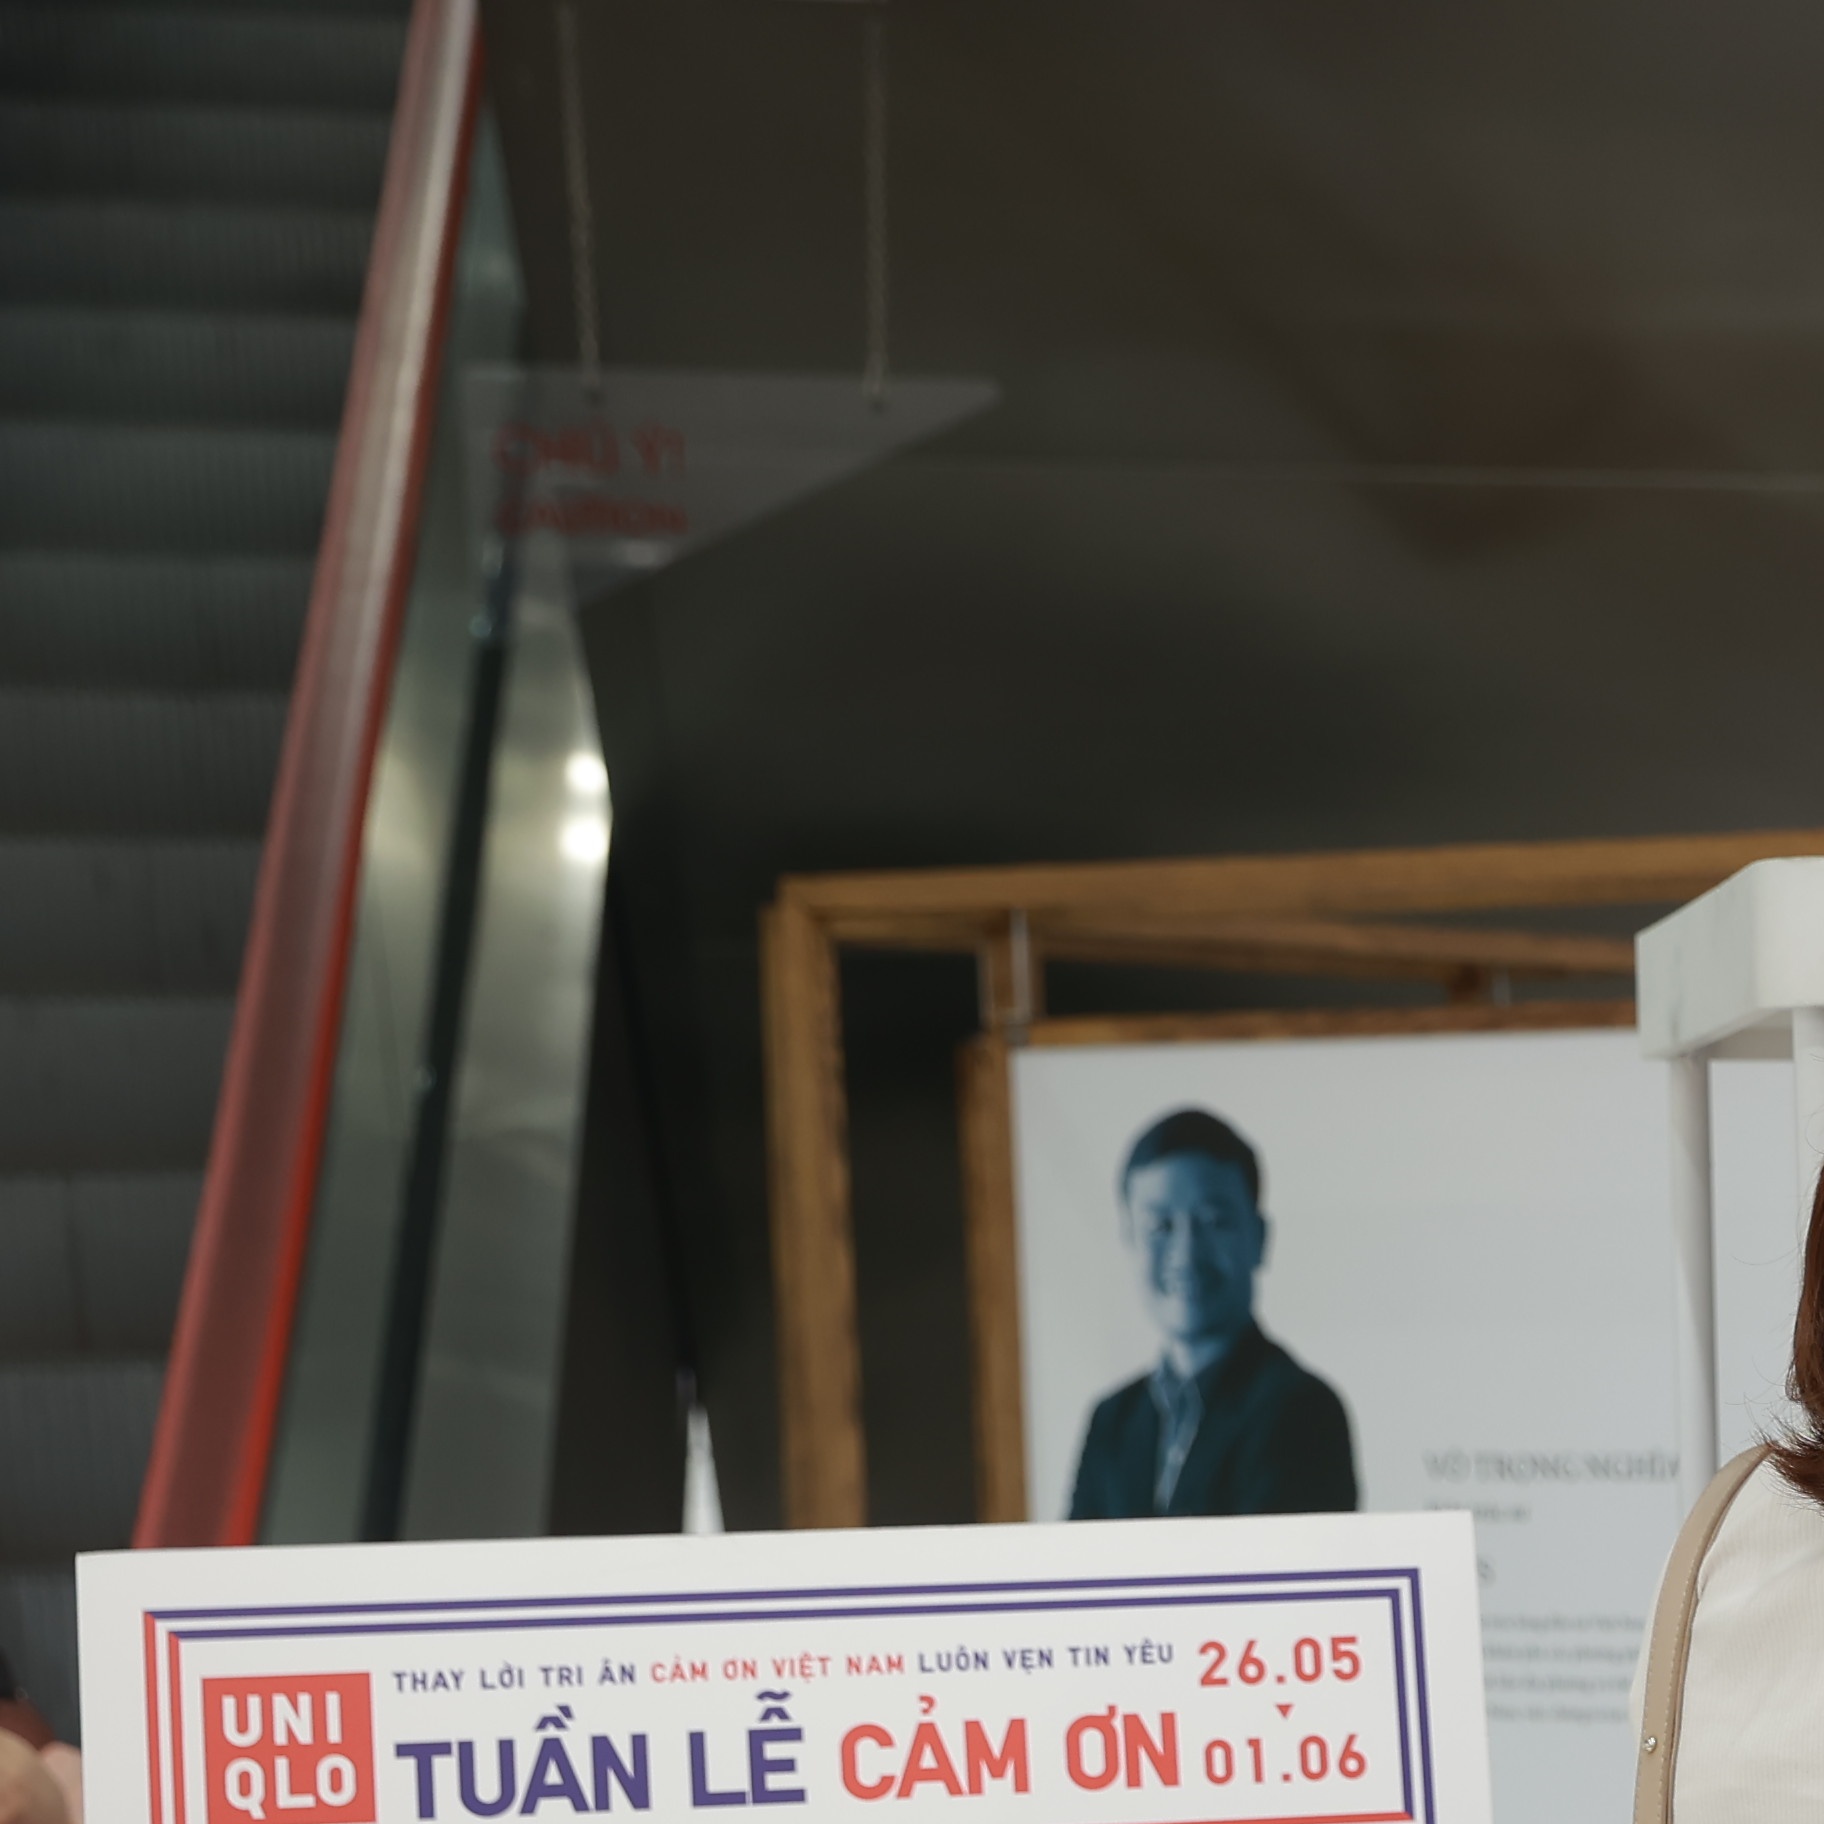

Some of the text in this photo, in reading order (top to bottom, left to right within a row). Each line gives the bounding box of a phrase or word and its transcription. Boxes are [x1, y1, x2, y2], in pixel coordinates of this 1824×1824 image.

[393, 1638, 1173, 1693] THAY LỜI TRI ÂN CẢM ƠN VIỆT NAM LUÔN VẸN TIN YÊU
[1198, 1635, 1361, 1687] 26.05
[221, 1691, 342, 1747] UNI
[394, 1690, 1180, 1820] TUẦN LỄ CẢM ƠN
[1204, 1733, 1367, 1786] 01.06
[224, 1754, 357, 1820] QLO
